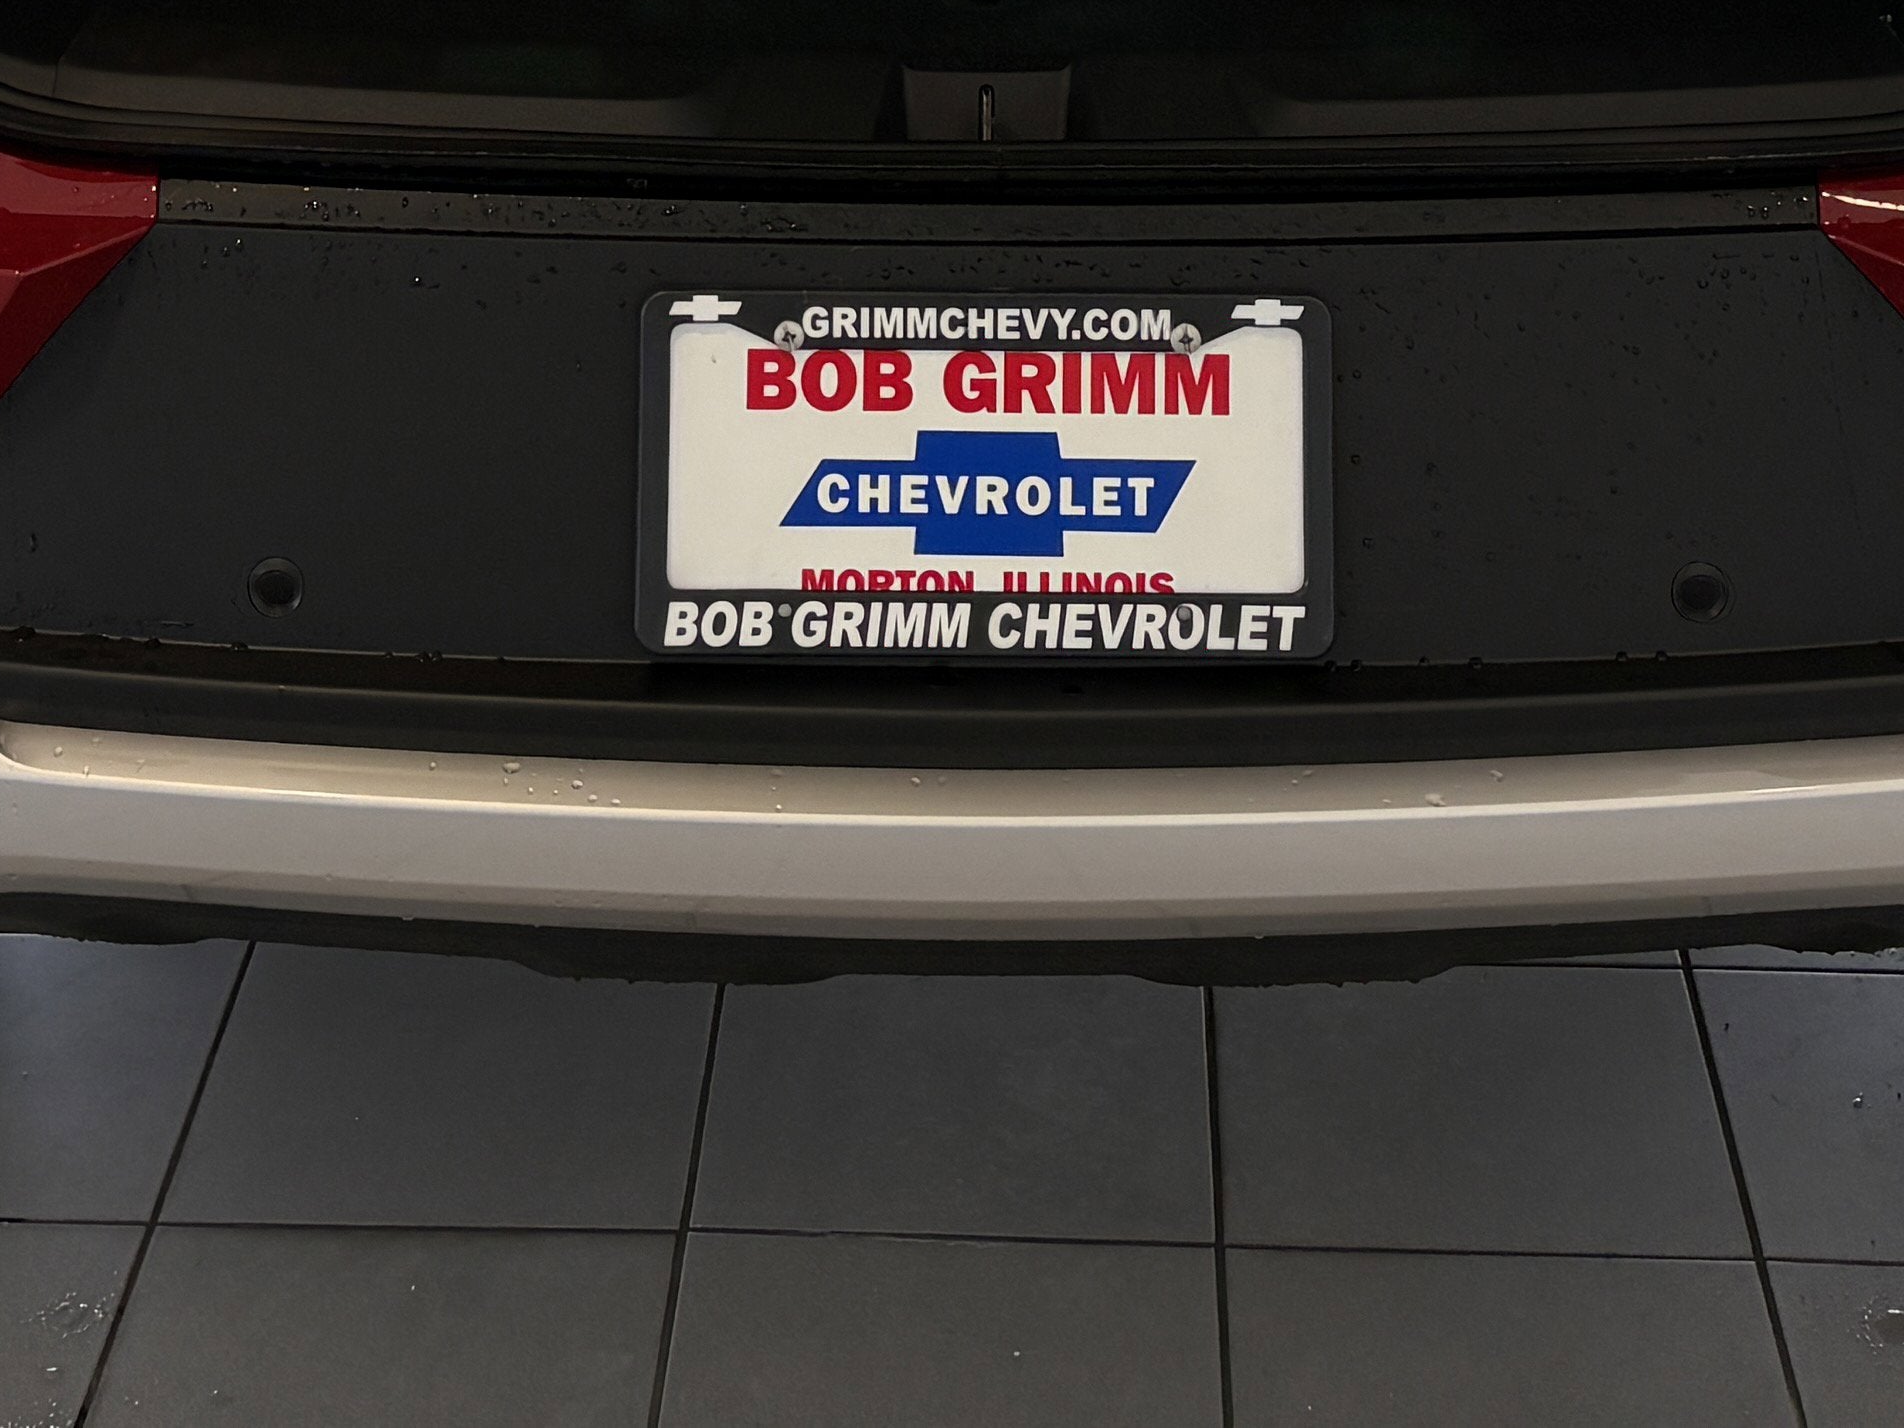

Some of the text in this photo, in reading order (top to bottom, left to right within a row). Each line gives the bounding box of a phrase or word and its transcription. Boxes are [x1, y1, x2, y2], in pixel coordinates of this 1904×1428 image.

[802, 306, 1171, 341] GRIMMCHEVY.COM
[746, 348, 1231, 416] BOB GRIMM
[817, 472, 1156, 517] CHEVROLET
[663, 600, 1307, 652] BOB GRIMM CHEVROLET
